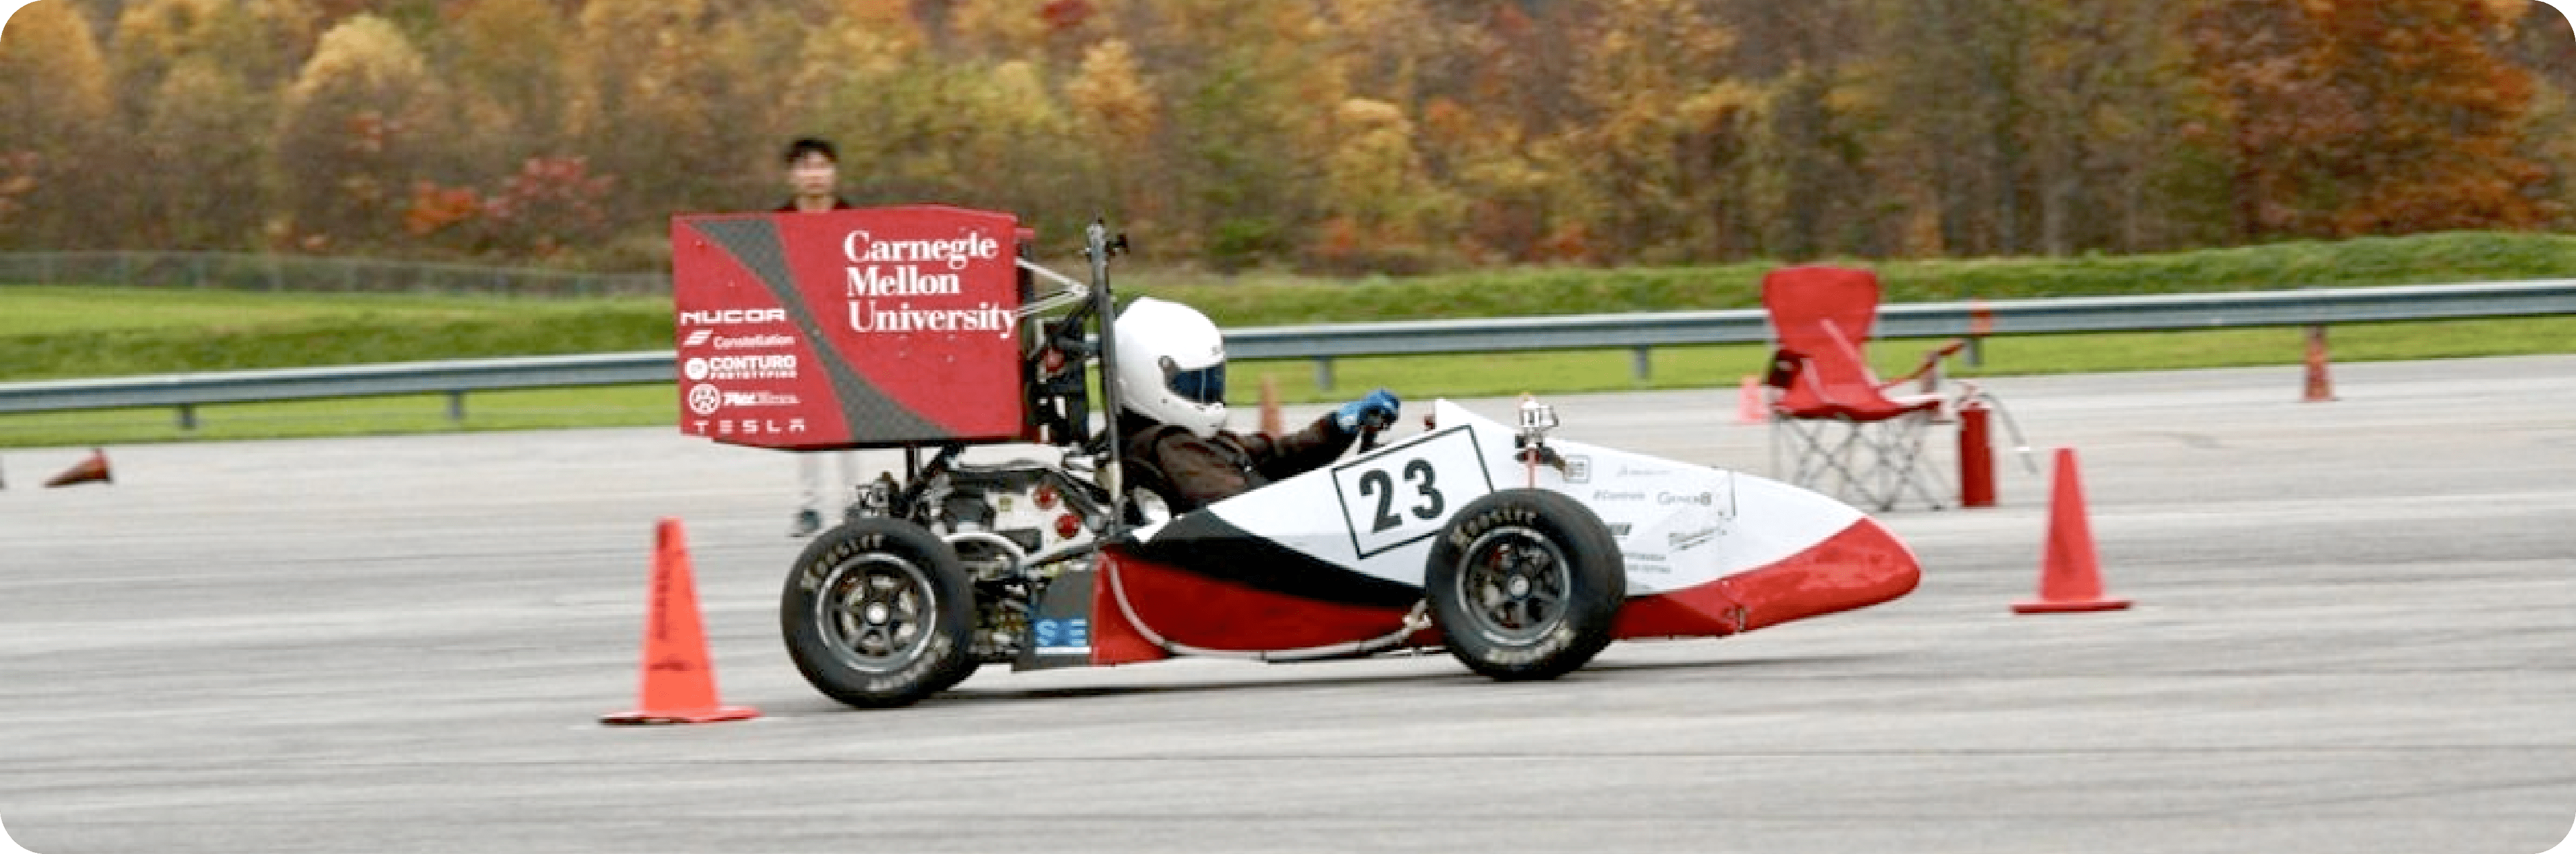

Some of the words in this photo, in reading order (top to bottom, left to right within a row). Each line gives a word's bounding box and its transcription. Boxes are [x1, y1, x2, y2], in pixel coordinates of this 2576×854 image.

[844, 230, 999, 269] Carnegie
[846, 265, 961, 297] Mellon
[680, 308, 787, 325] NUCOR
[849, 300, 1018, 339] University
[709, 355, 797, 370] CONTURO
[694, 418, 806, 434] TESLA
[1358, 459, 1445, 534] 23
